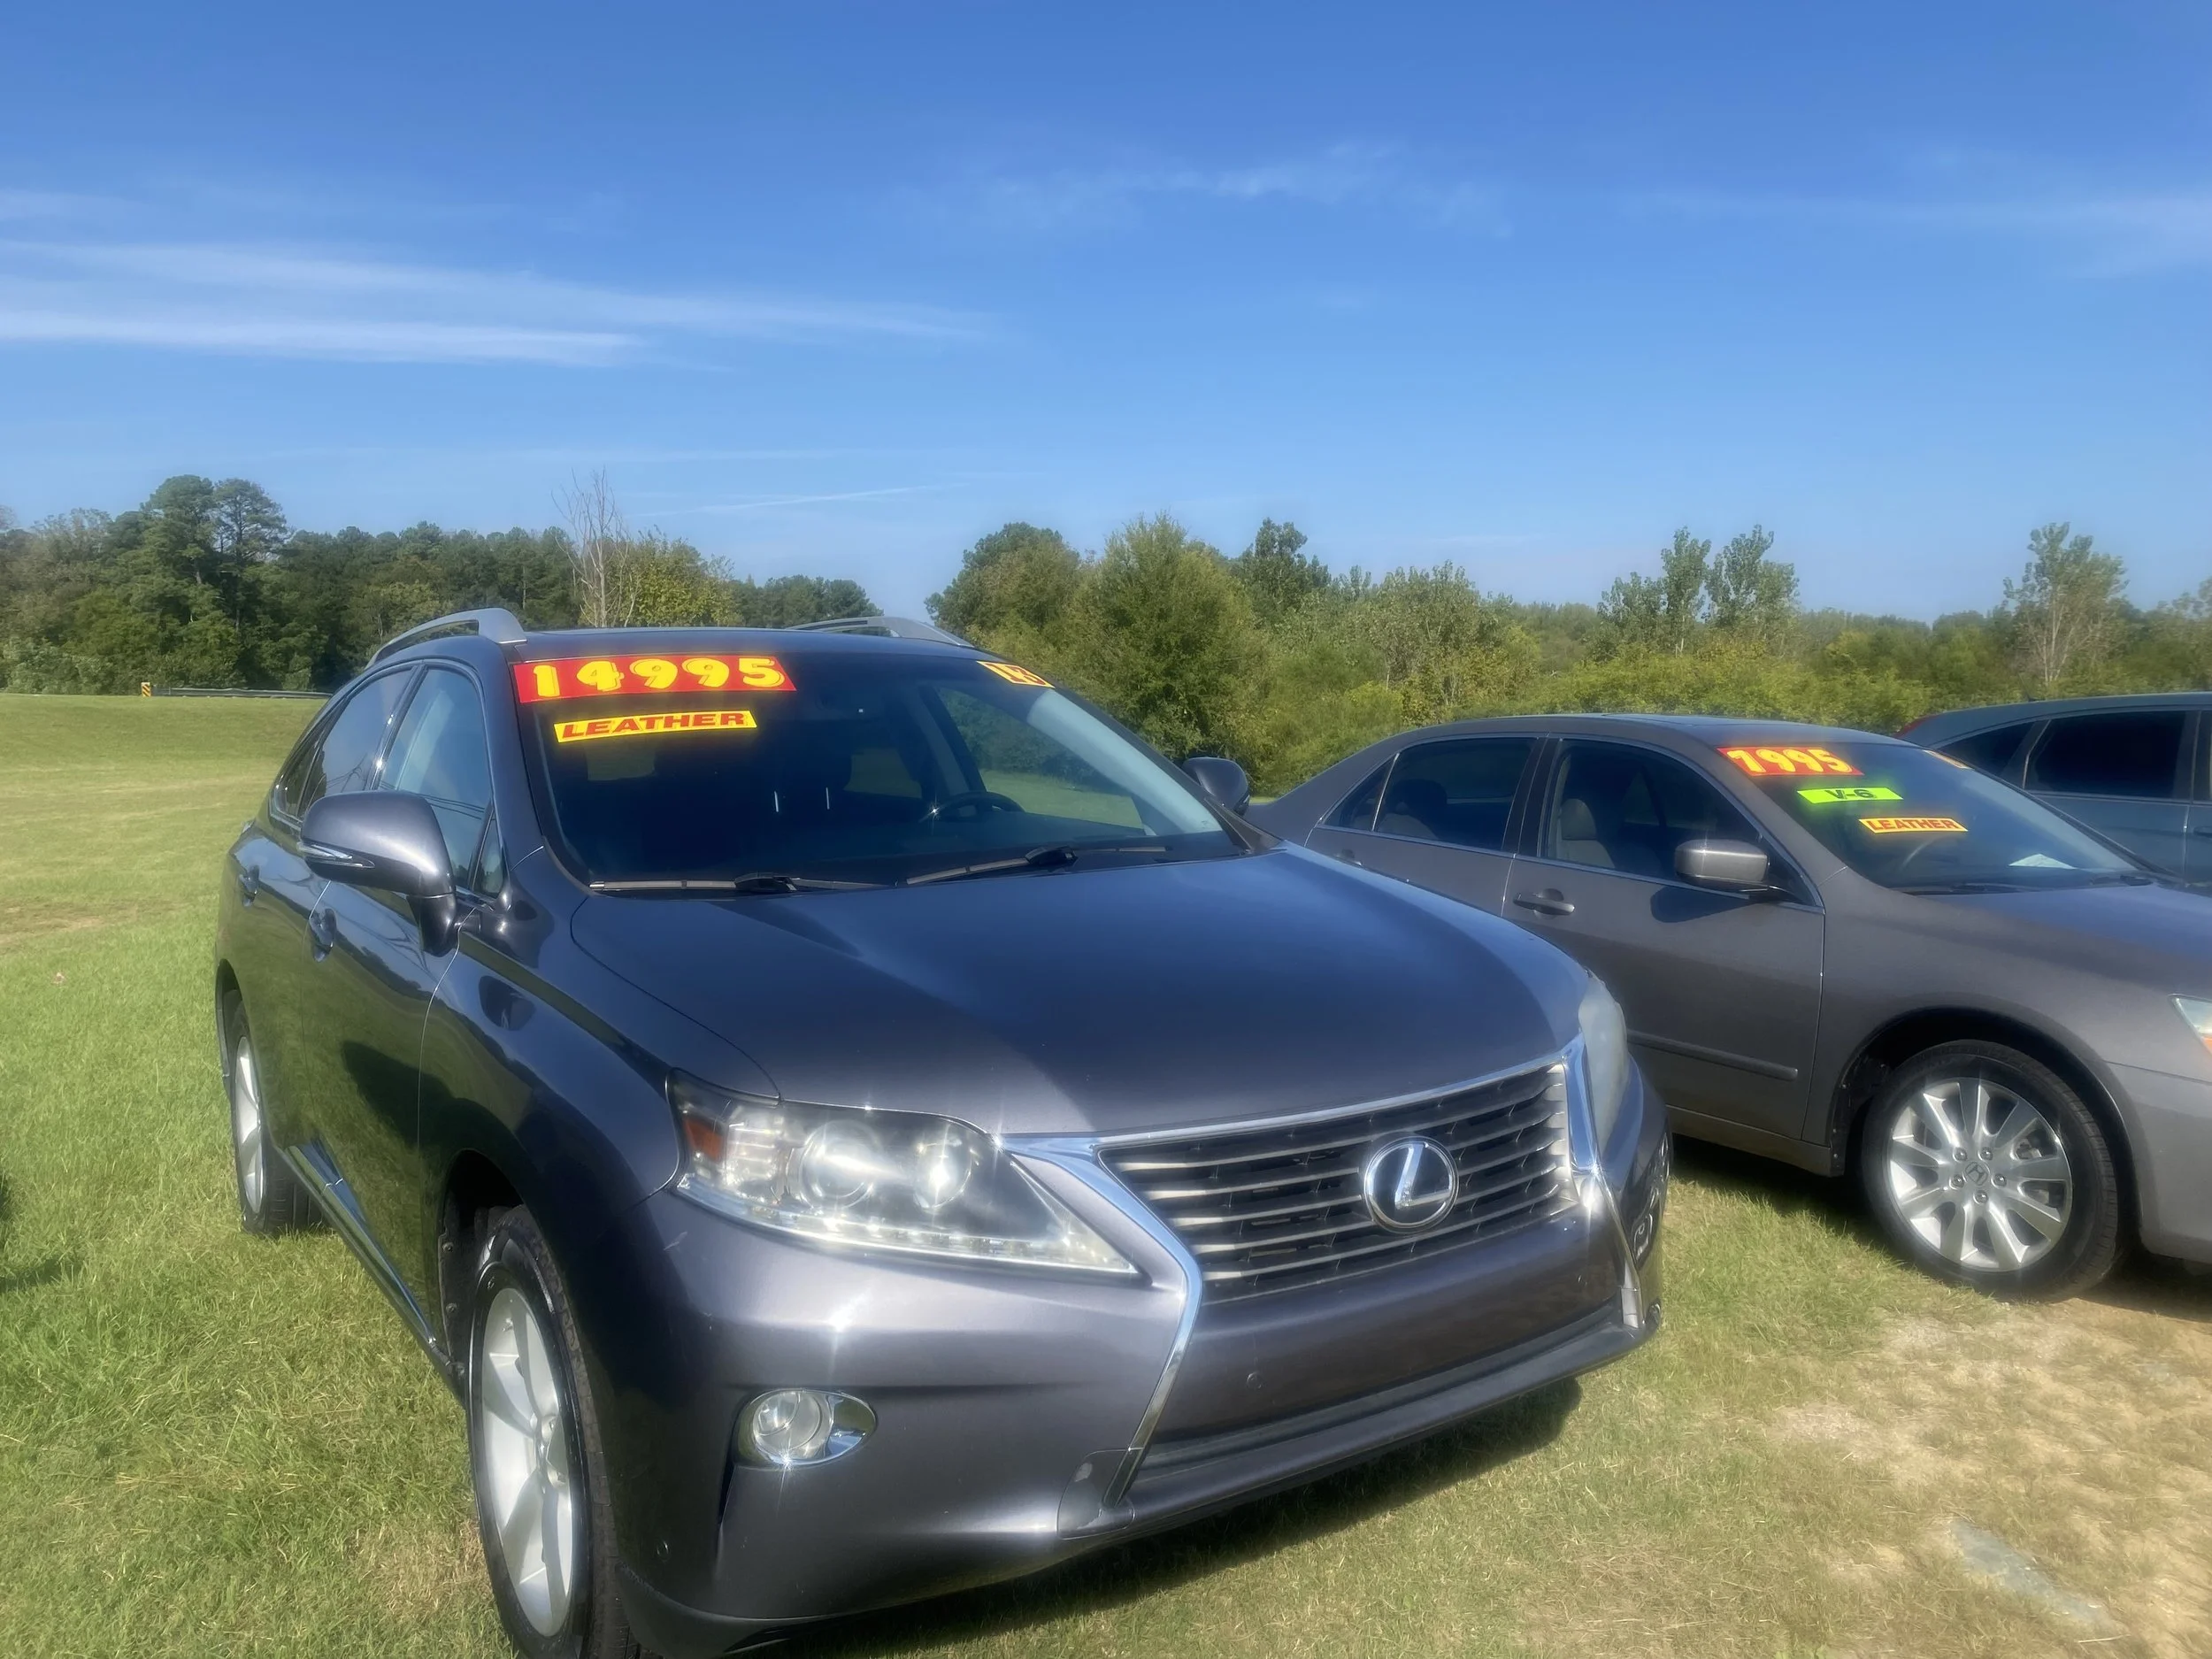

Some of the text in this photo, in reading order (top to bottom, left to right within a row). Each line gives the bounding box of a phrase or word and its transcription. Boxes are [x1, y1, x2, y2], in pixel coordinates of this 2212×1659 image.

[534, 657, 785, 696] 14995
[984, 663, 1047, 686] 13
[563, 712, 746, 739] LEATHER
[1726, 749, 1853, 773] 7995
[1825, 788, 1873, 800] V-6
[1866, 818, 1959, 831] LEATHER
